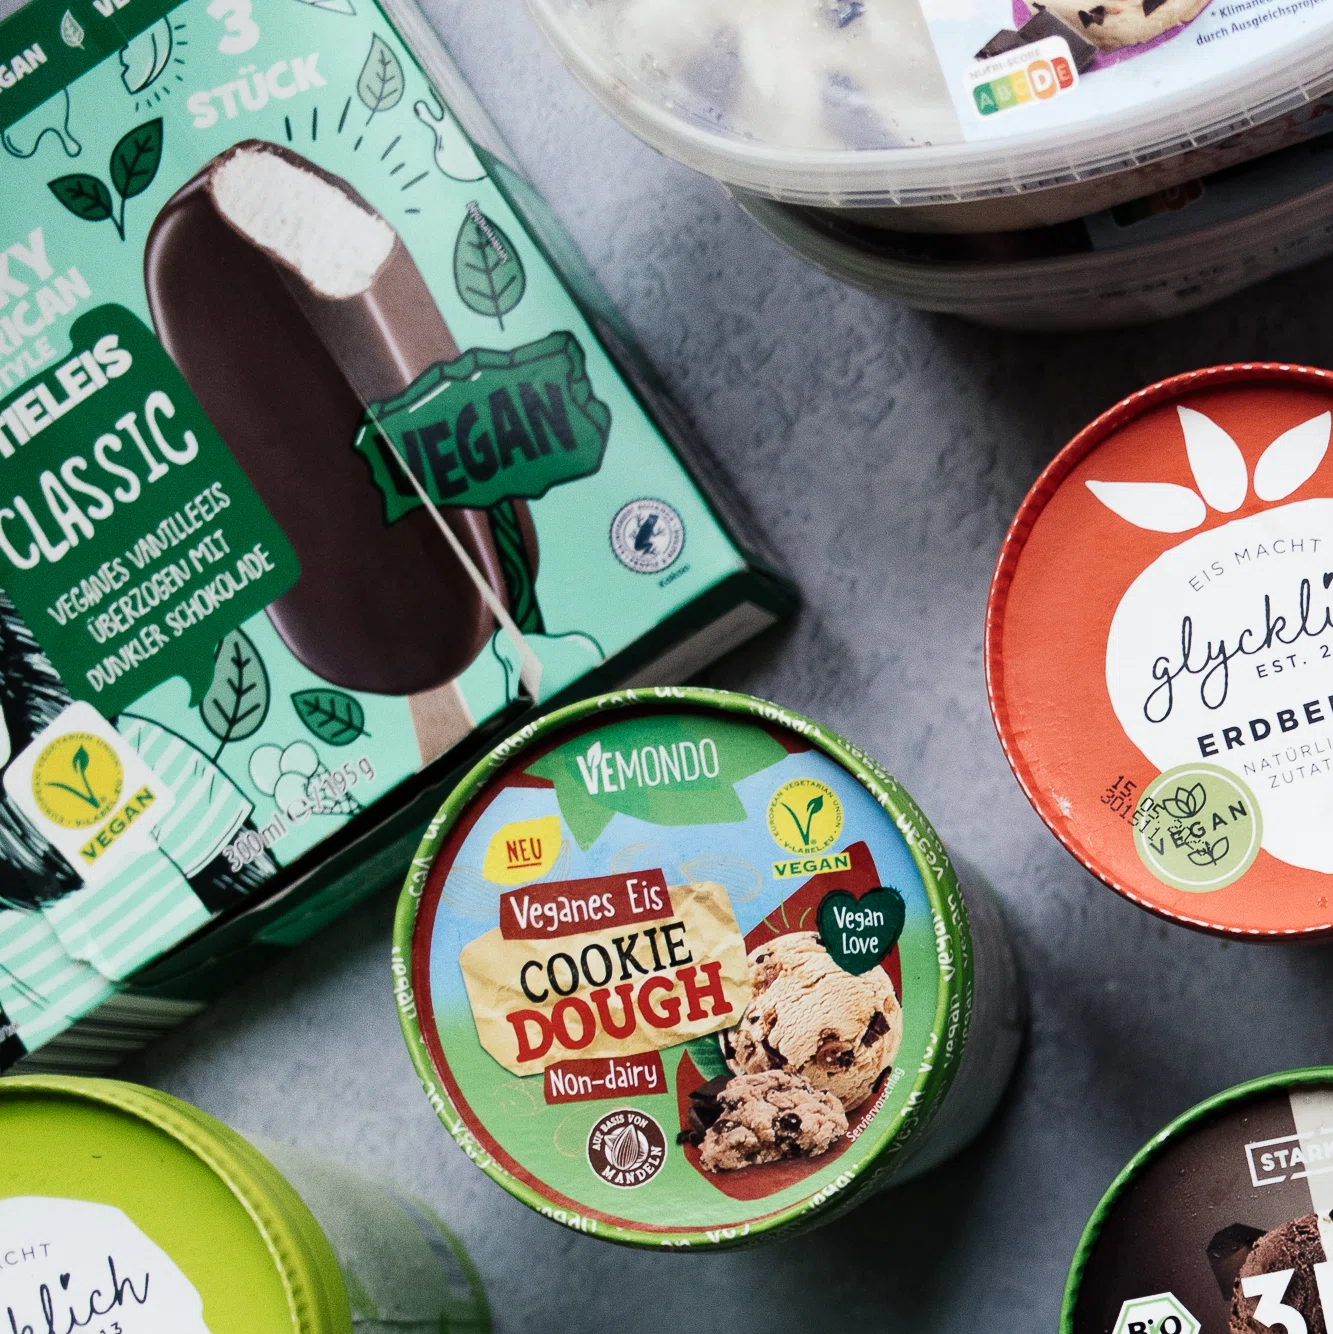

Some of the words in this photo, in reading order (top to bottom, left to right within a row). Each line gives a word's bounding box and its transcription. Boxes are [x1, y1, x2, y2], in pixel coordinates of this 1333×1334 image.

[207, 0, 260, 55] 3
[1195, 28, 1229, 46] durch
[186, 52, 327, 129] STÜCK
[0, 391, 199, 569] CLASSIC
[47, 558, 130, 626] VEGANES
[87, 559, 191, 644] ÜBERZOGEN
[188, 529, 231, 572] MIT
[1188, 560, 1225, 592] EIS
[1234, 537, 1323, 566] MACHT
[86, 625, 169, 692] DUNKLER
[165, 543, 275, 636] SCHOKOLADE
[1255, 655, 1308, 678] EST.
[82, 789, 156, 860] VEGAN
[506, 836, 543, 864] NEU
[1150, 799, 1250, 855] VEGAN
[775, 854, 848, 876] VEGAN
[509, 890, 617, 934] Veganes
[625, 879, 662, 915] Eis
[833, 905, 884, 935] Vegan
[519, 921, 694, 1004] COOKIE
[840, 933, 879, 956] Love
[506, 962, 734, 1063] DOUGH
[549, 1060, 659, 1098] Non-dairy
[845, 1067, 904, 1143] Serviervorschlag
[602, 1145, 664, 1186] MANDELN
